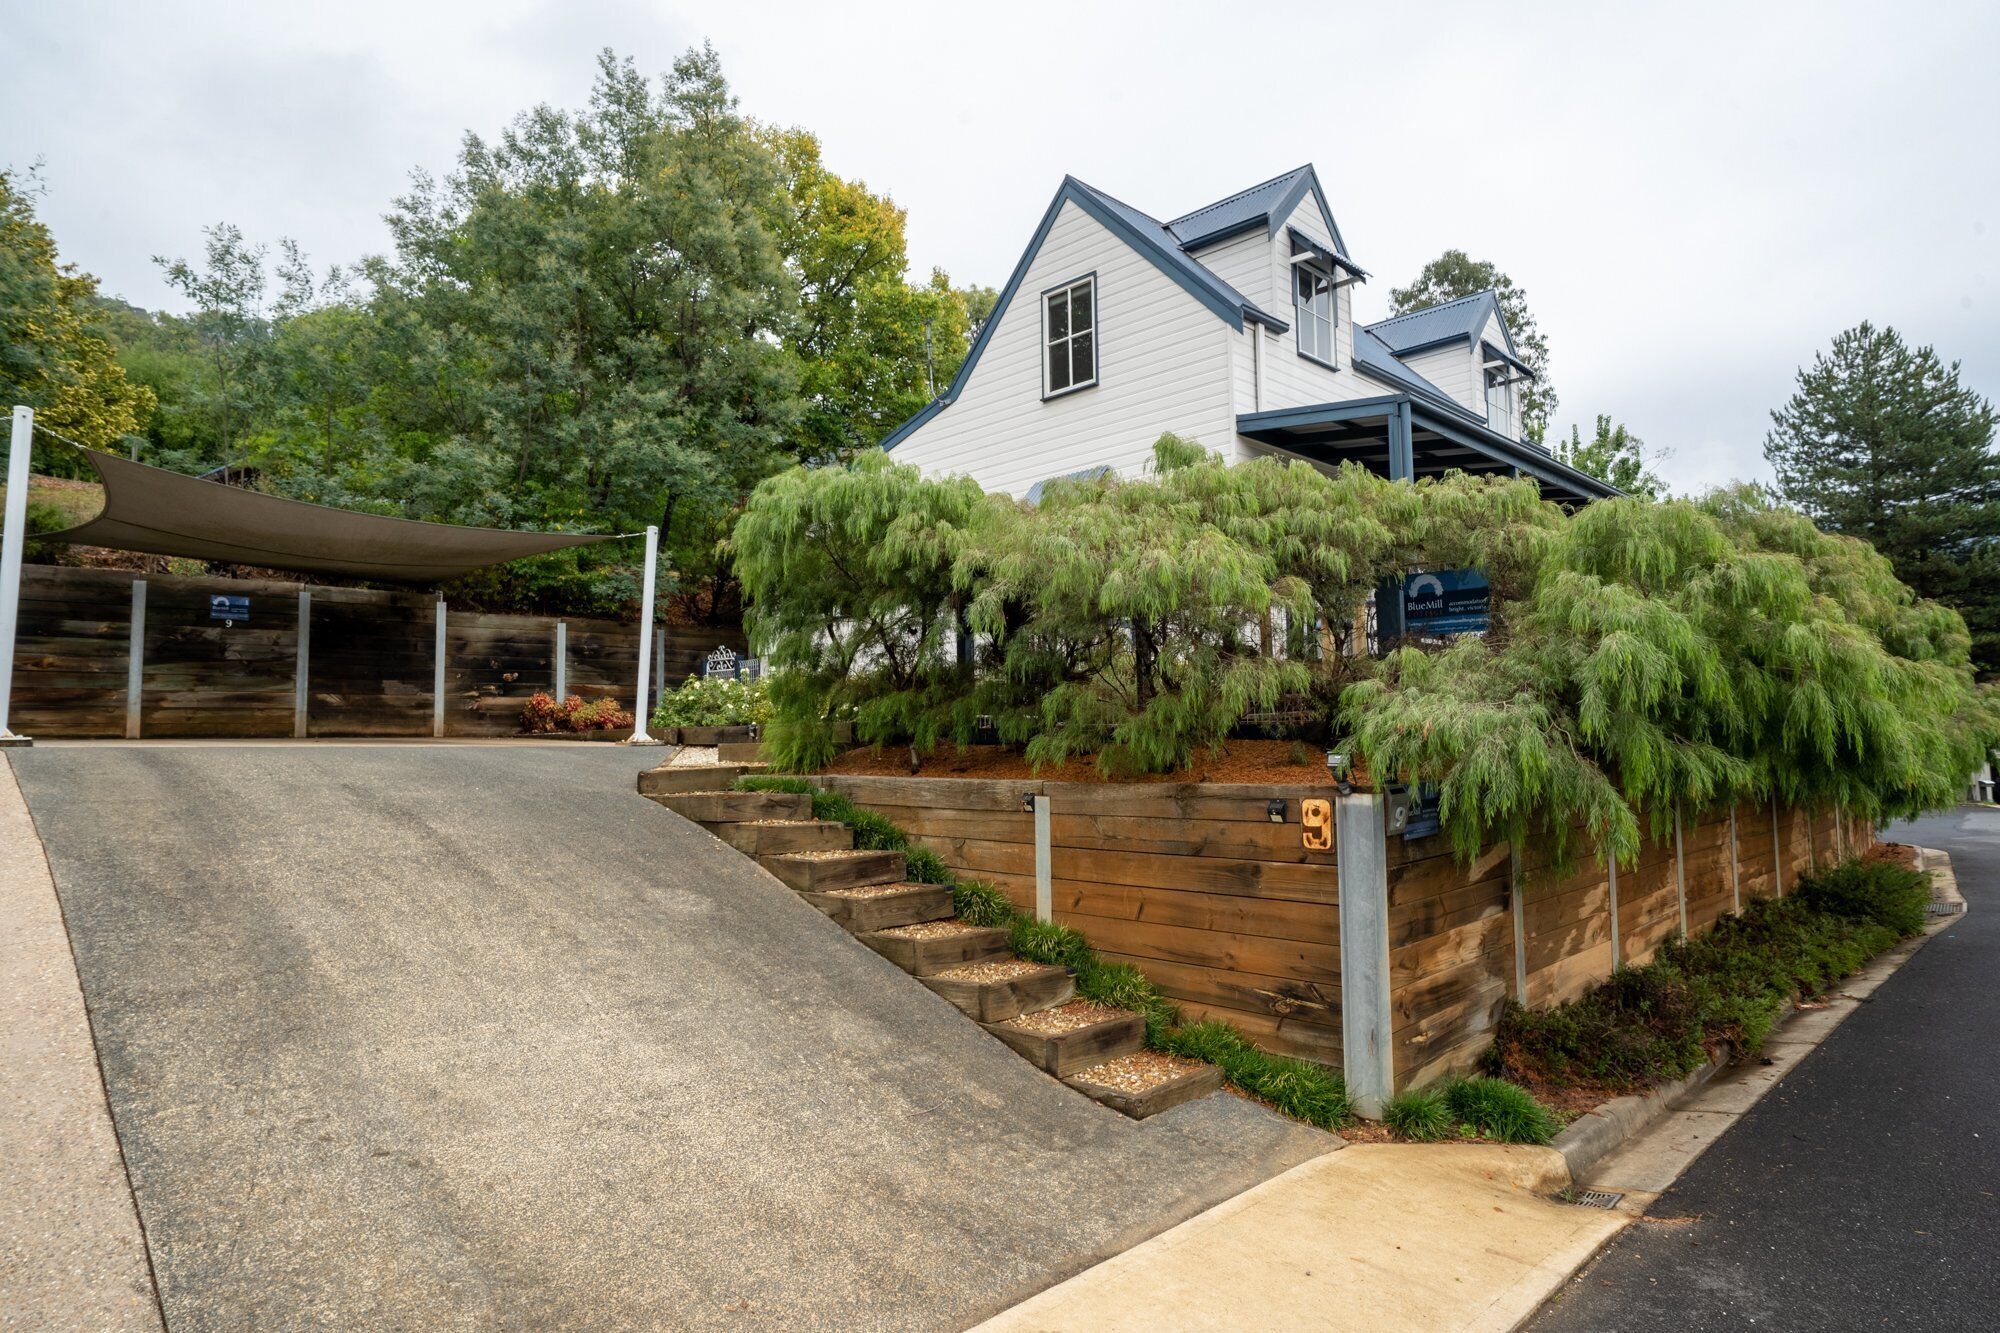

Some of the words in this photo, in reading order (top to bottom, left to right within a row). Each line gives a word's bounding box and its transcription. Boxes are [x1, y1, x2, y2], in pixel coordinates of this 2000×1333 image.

[1407, 599, 1443, 611] BlueMill
[225, 619, 233, 628] 9
[1301, 799, 1332, 850] 9
[1395, 806, 1406, 828] 9
